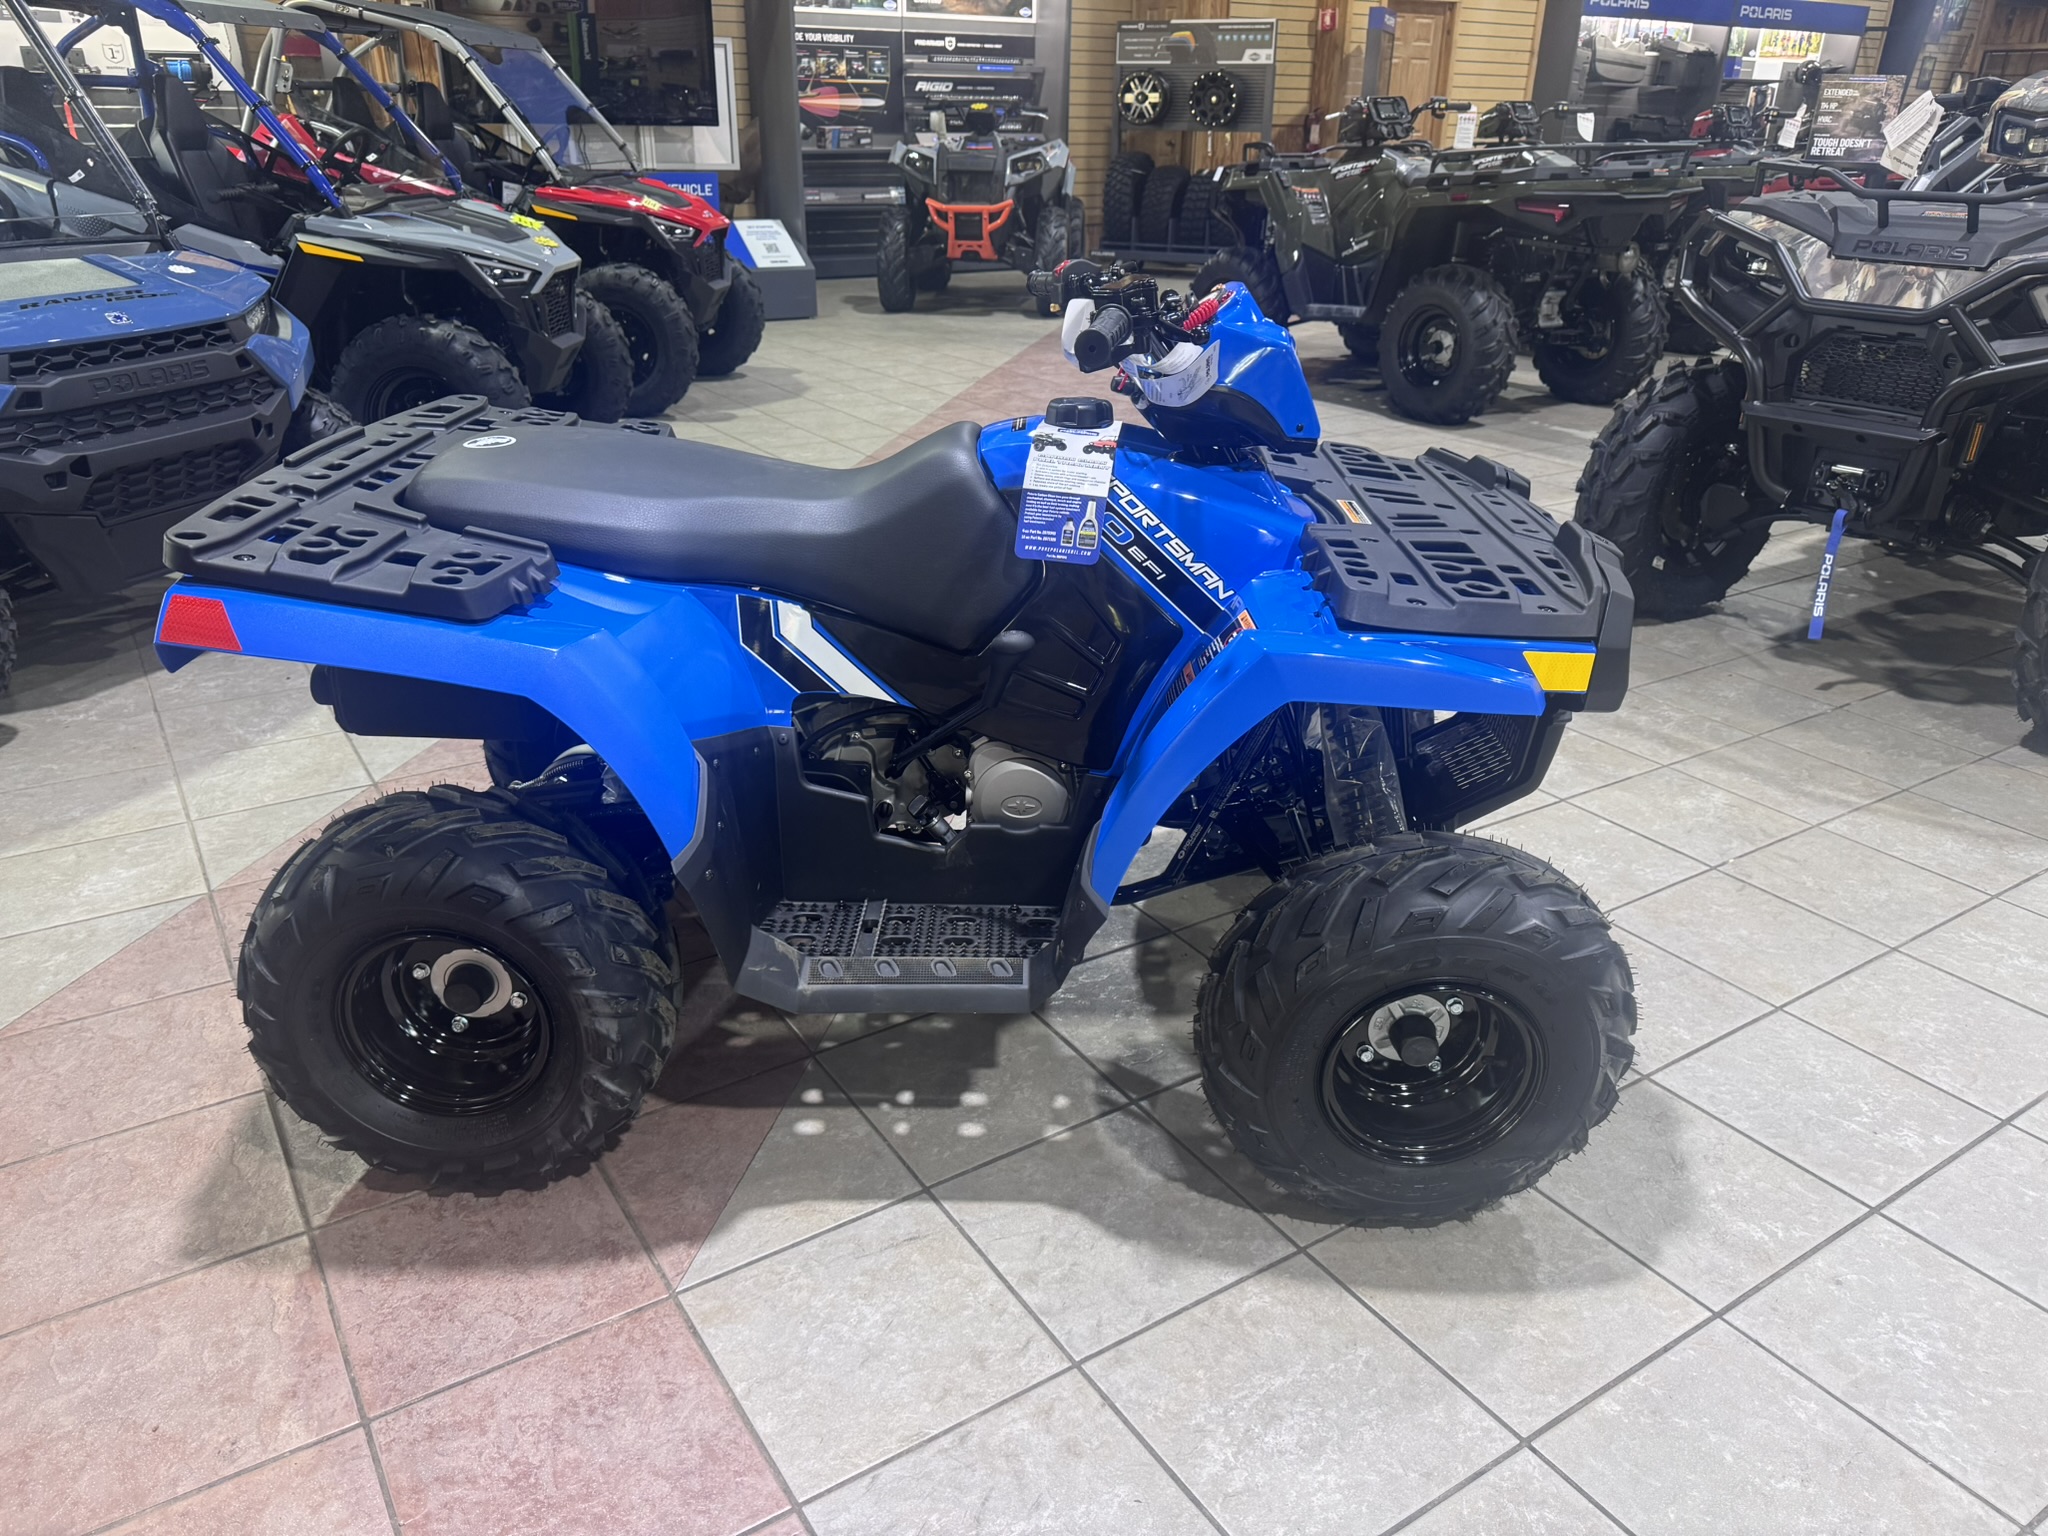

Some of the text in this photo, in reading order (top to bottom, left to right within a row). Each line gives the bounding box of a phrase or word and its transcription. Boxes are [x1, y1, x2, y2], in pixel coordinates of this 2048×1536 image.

[1740, 5, 1793, 21] POLARIS
[804, 32, 822, 42] YOUR
[822, 33, 855, 43] VISIBILITY
[915, 81, 953, 92] RIGID
[1823, 88, 1854, 97] EXTENDED
[1813, 137, 1873, 149] TOUGH DOESN'T
[1810, 146, 1846, 157] RETREAT
[667, 183, 713, 196] HICLE
[1852, 240, 1972, 262] POLARIS
[19, 289, 144, 310] RANGER
[88, 360, 210, 399] POLARIS
[1110, 476, 1234, 600] PORTSMAN
[1127, 545, 1167, 581] EFI
[1812, 553, 1834, 617] POLARIS
